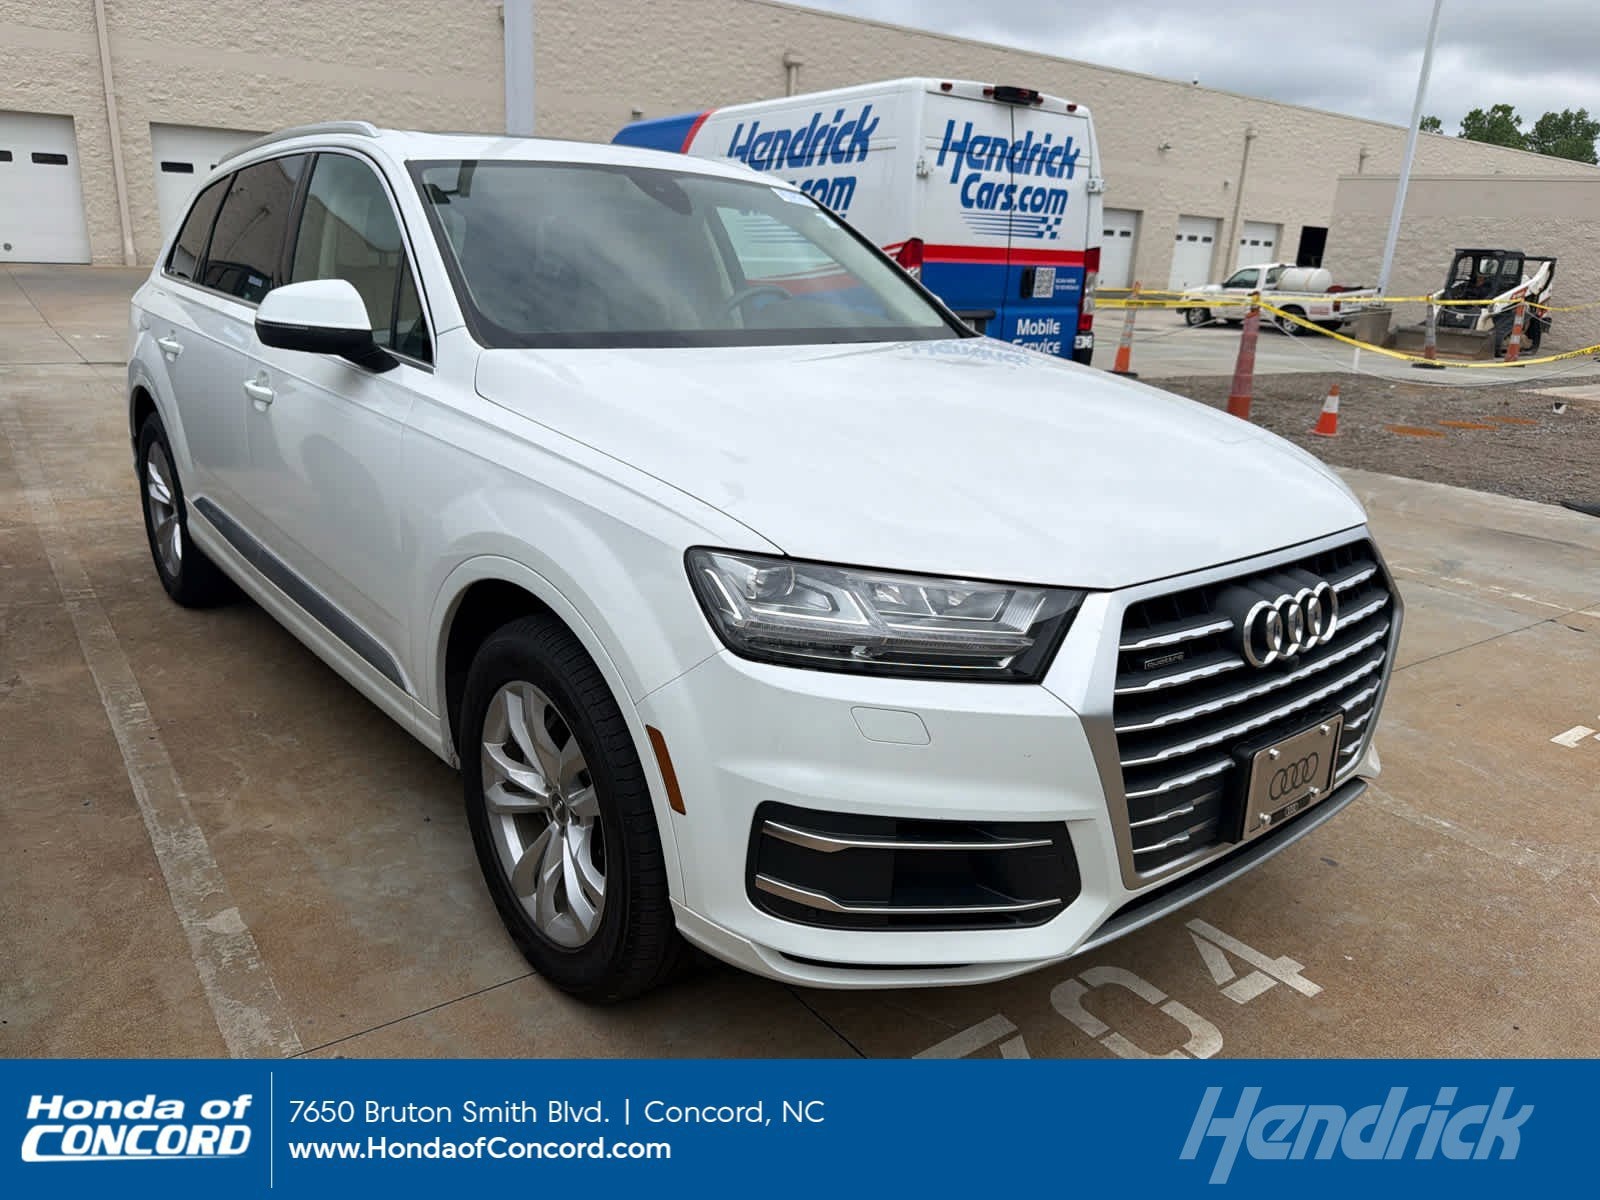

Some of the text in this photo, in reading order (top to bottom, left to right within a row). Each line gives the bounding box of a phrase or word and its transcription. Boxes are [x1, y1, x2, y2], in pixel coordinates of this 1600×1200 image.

[727, 104, 880, 172] Hendrick
[936, 119, 1081, 184] Hendrick
[960, 173, 1068, 215] Cars.com
[1016, 318, 1061, 336] Mobile
